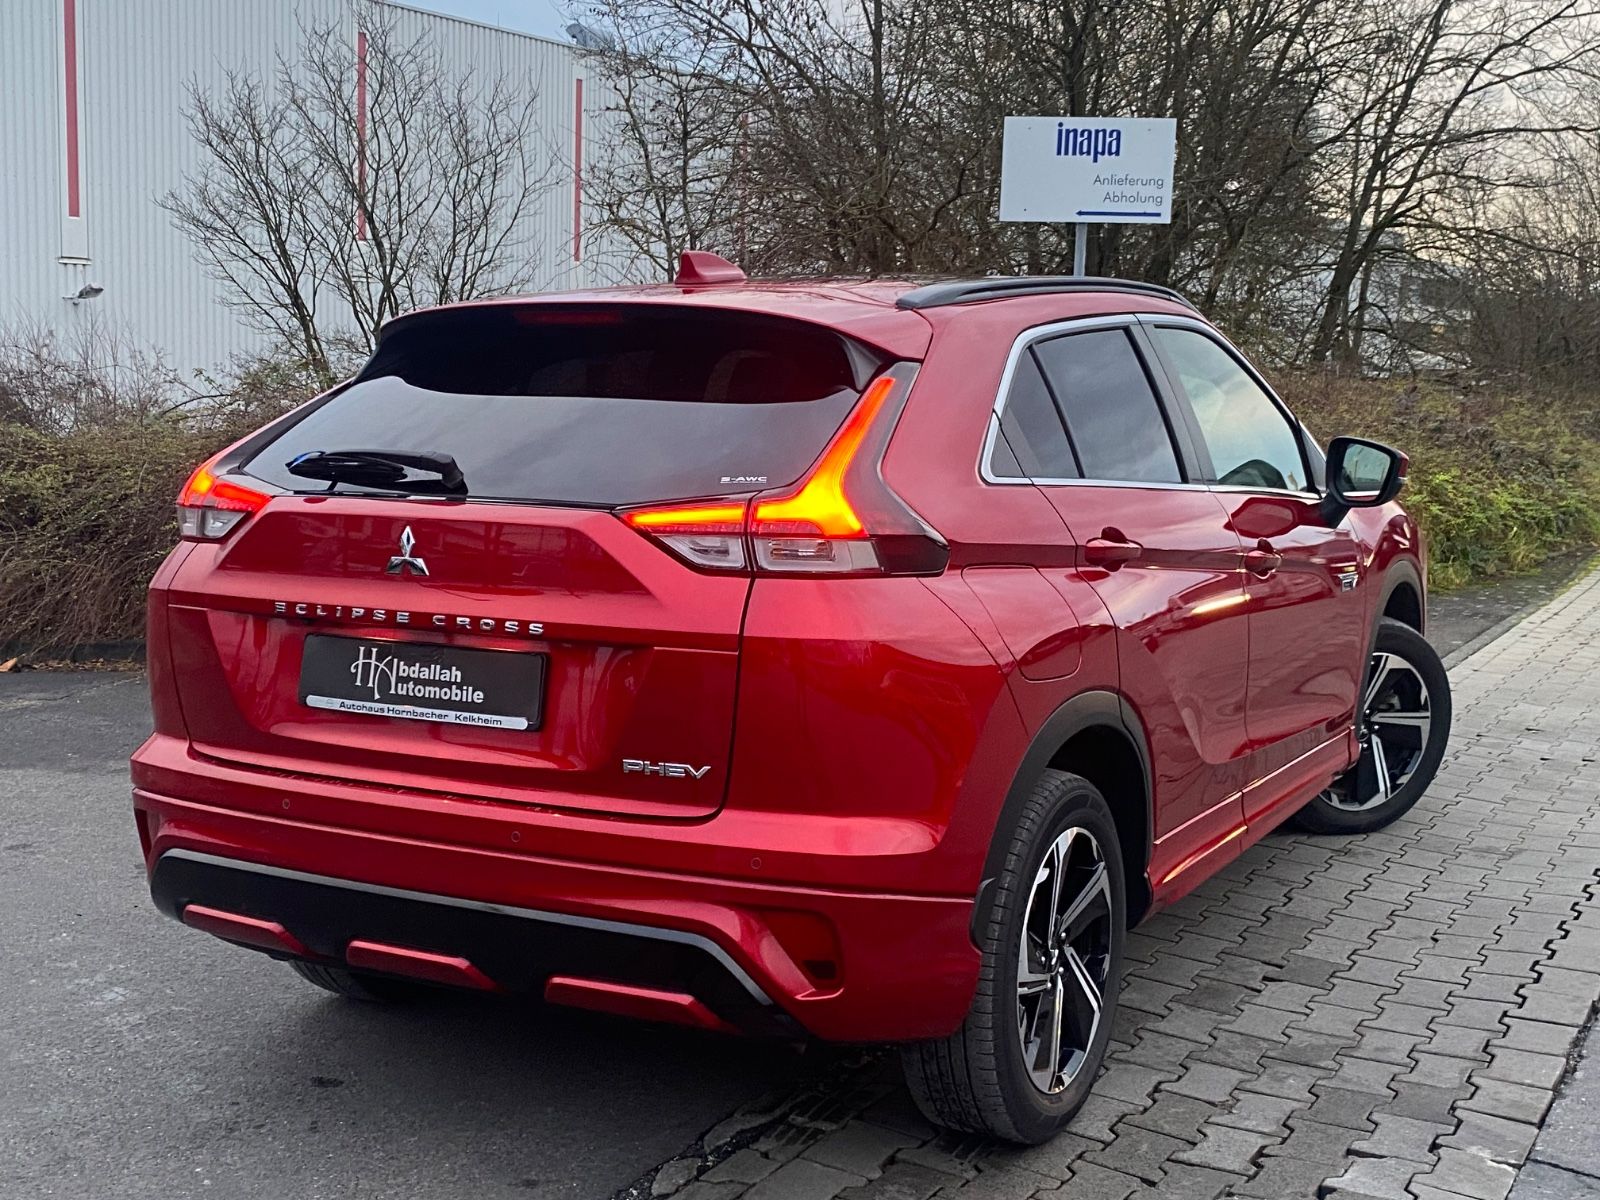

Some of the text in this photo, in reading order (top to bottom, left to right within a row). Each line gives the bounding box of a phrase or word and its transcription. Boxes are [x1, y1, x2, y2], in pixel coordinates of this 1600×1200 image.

[1056, 121, 1122, 163] inapa
[1093, 174, 1164, 189] Anlieferung
[1103, 191, 1163, 206] Abholung
[274, 602, 544, 635] ECLIPSE CROSS
[339, 701, 503, 726] Autohaus Hornbacher Kelkheim
[622, 759, 711, 779] PHEV
